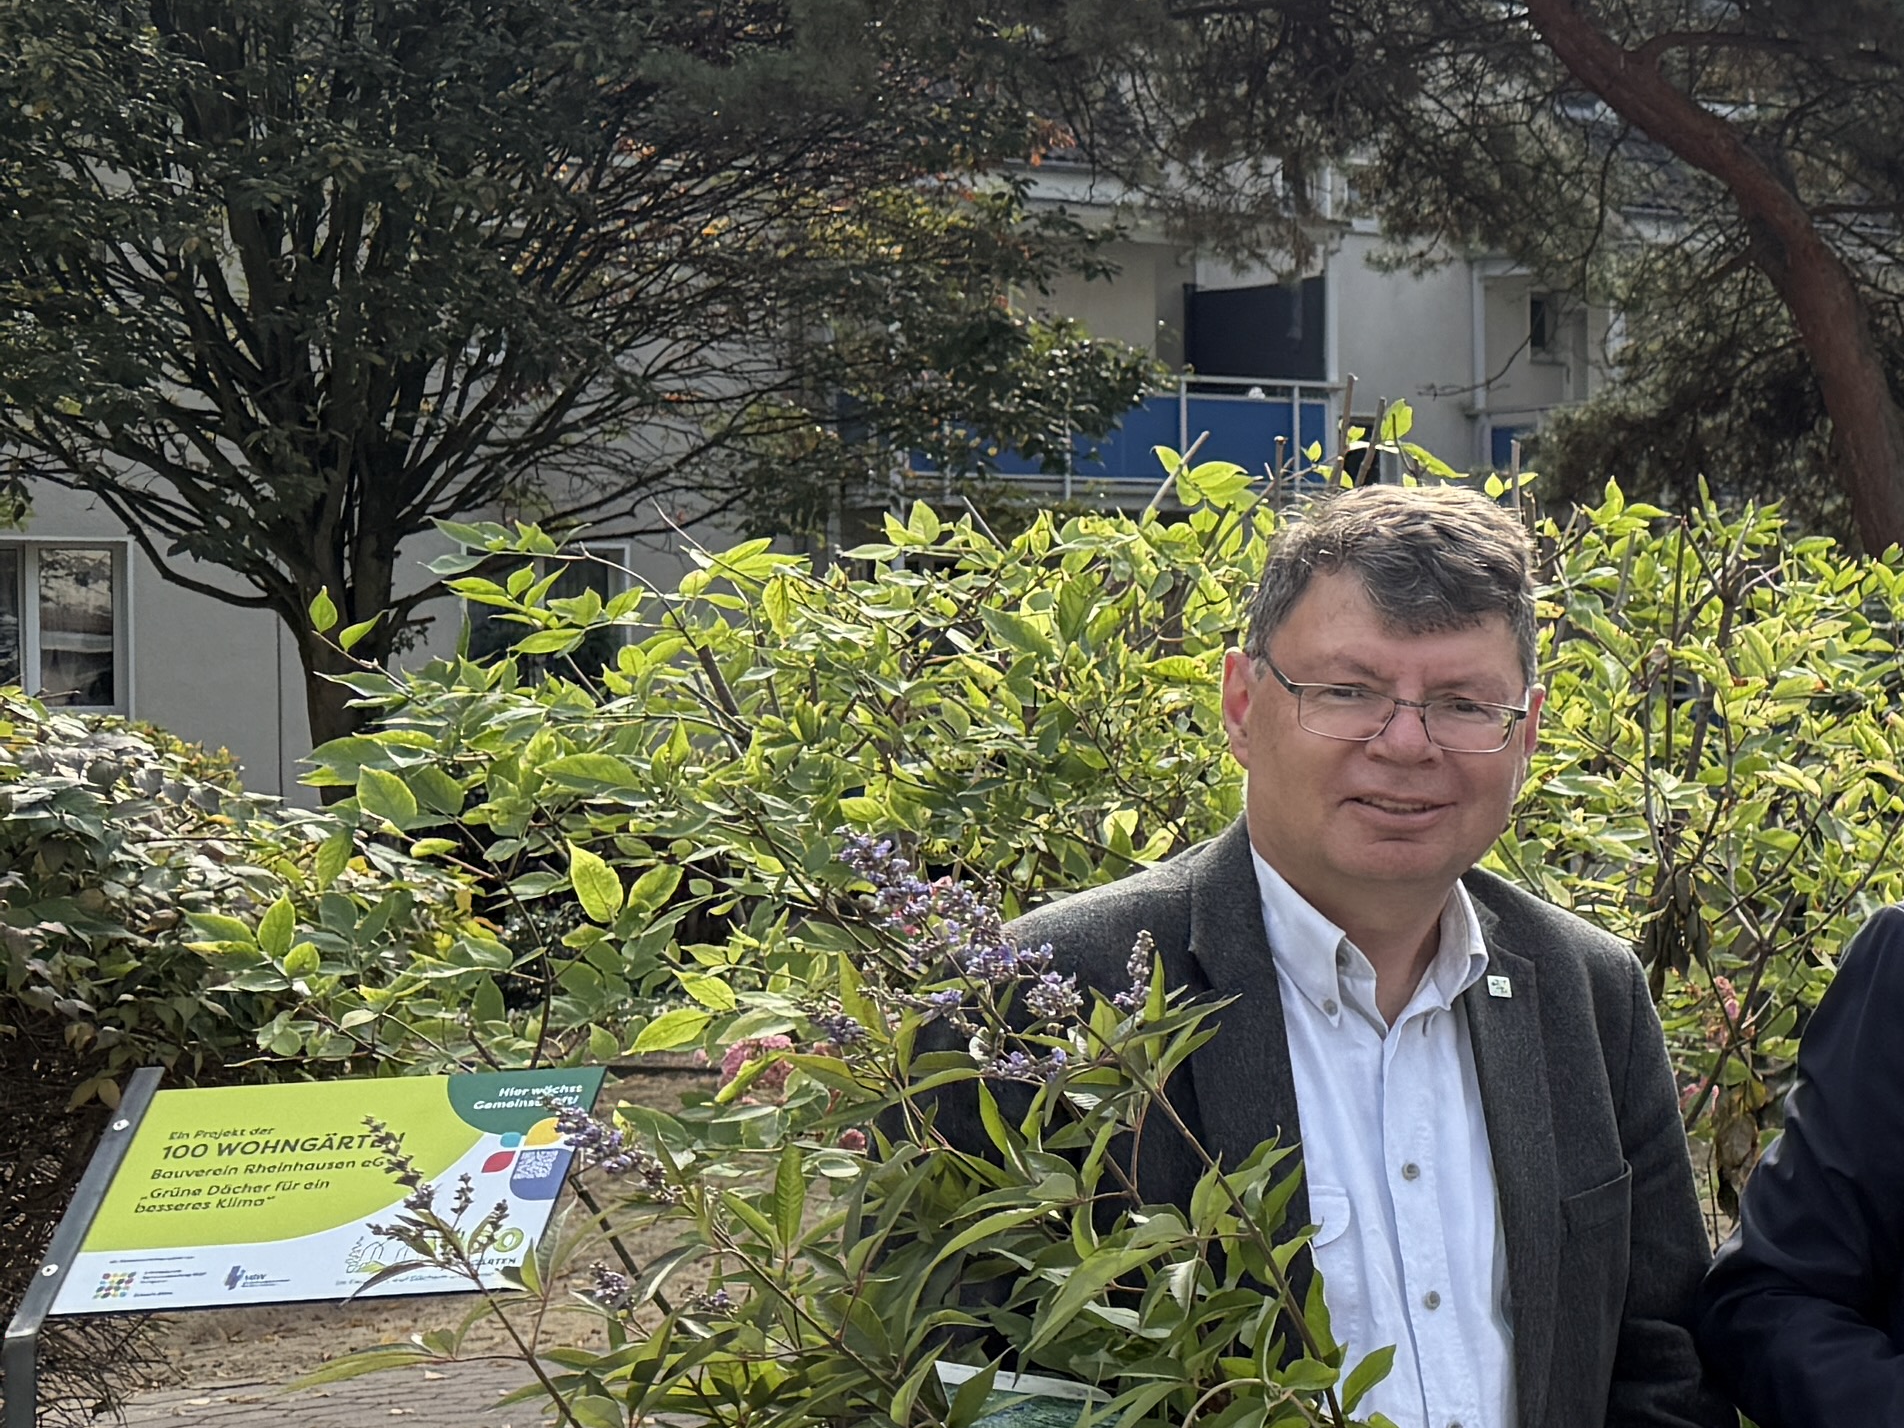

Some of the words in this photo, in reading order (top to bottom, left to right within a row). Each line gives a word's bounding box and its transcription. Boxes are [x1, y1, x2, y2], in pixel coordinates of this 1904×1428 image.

[499, 1087, 529, 1097] Hier
[168, 1131, 190, 1140] Ein
[193, 1127, 246, 1140] Projekt
[249, 1125, 275, 1136] der
[162, 1143, 209, 1160] 100
[150, 1165, 239, 1180] Bauverein
[244, 1159, 357, 1174] Rheinhausen
[361, 1157, 385, 1168] eG
[207, 1181, 269, 1195] Dächer
[275, 1180, 300, 1192] für
[304, 1178, 330, 1190] ein
[134, 1200, 211, 1214] besseres
